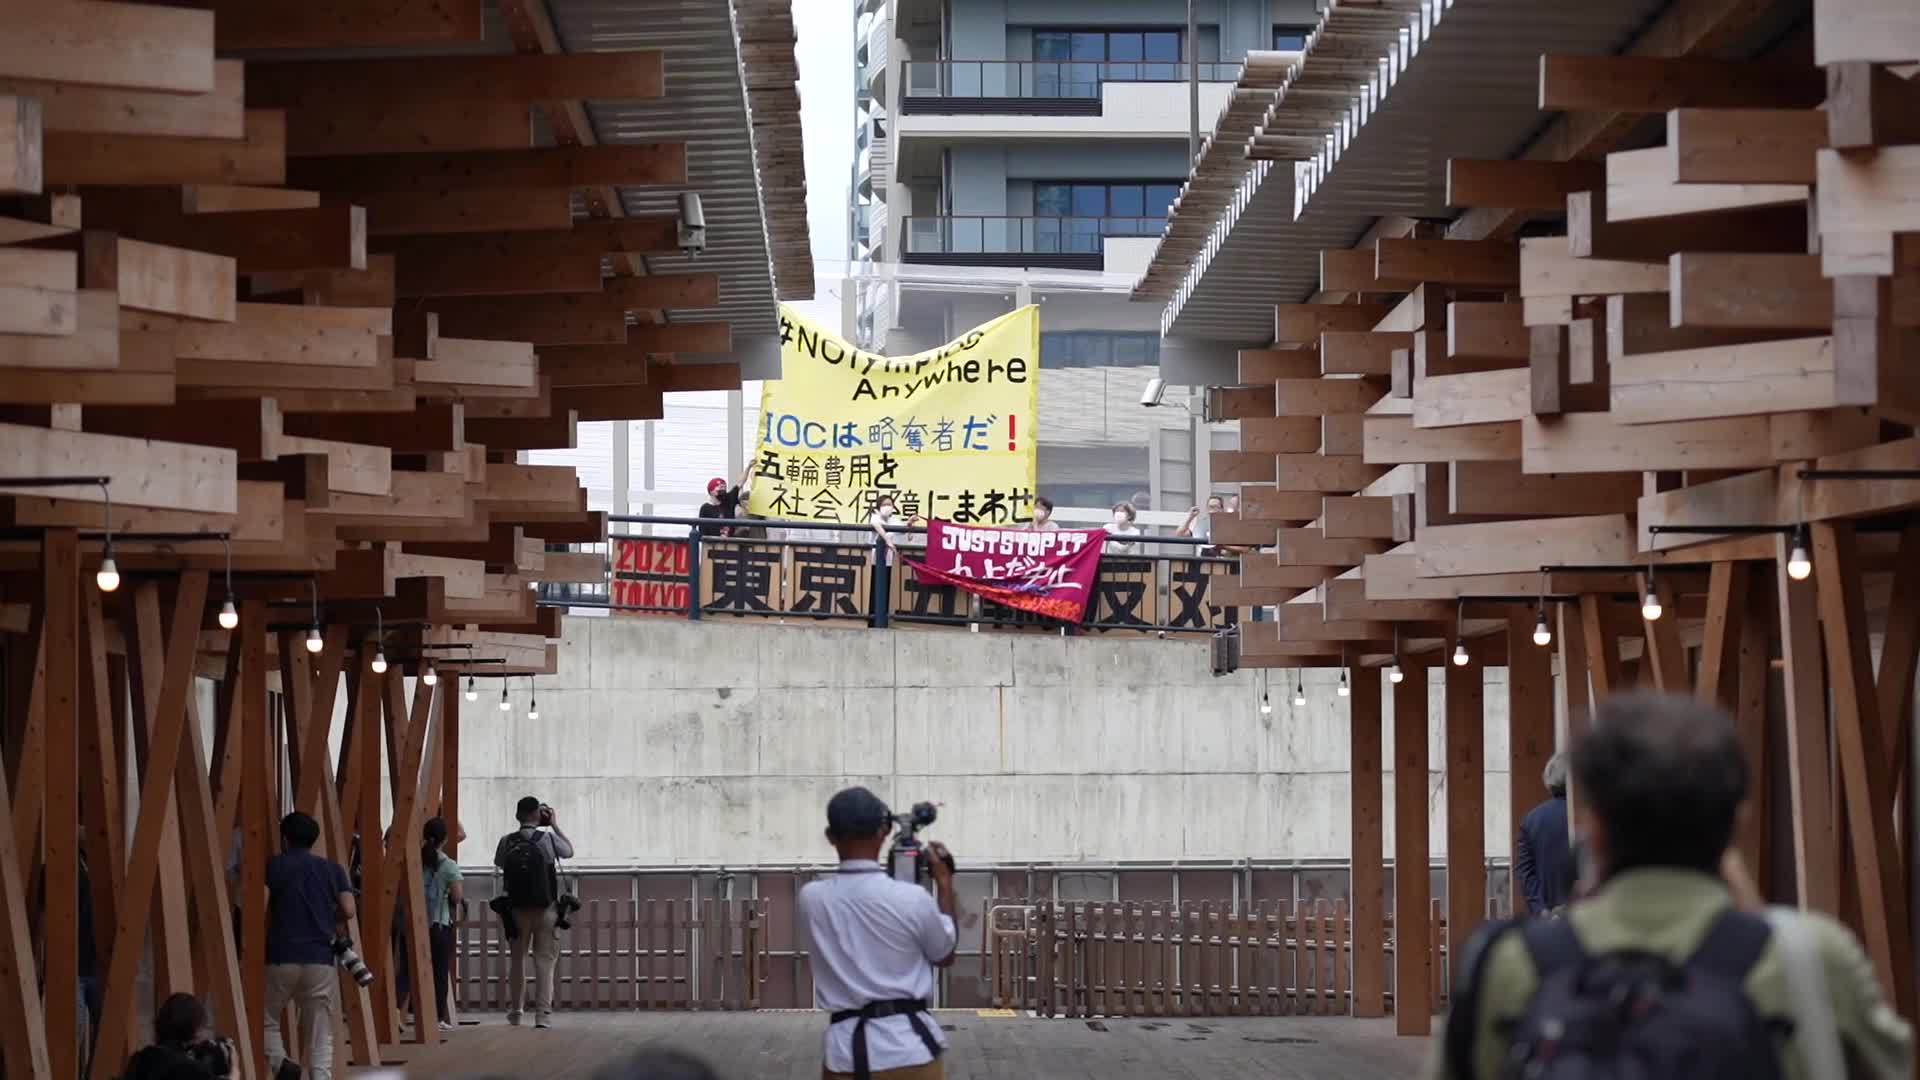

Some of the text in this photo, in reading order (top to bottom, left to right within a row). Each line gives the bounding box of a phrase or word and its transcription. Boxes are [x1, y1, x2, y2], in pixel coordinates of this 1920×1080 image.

[852, 357, 1027, 400] Anywhere
[755, 451, 899, 489] 五輪費用を
[615, 539, 690, 574] 2020
[942, 525, 1088, 557] JUST STOP IT
[613, 580, 690, 615] TOKYO
